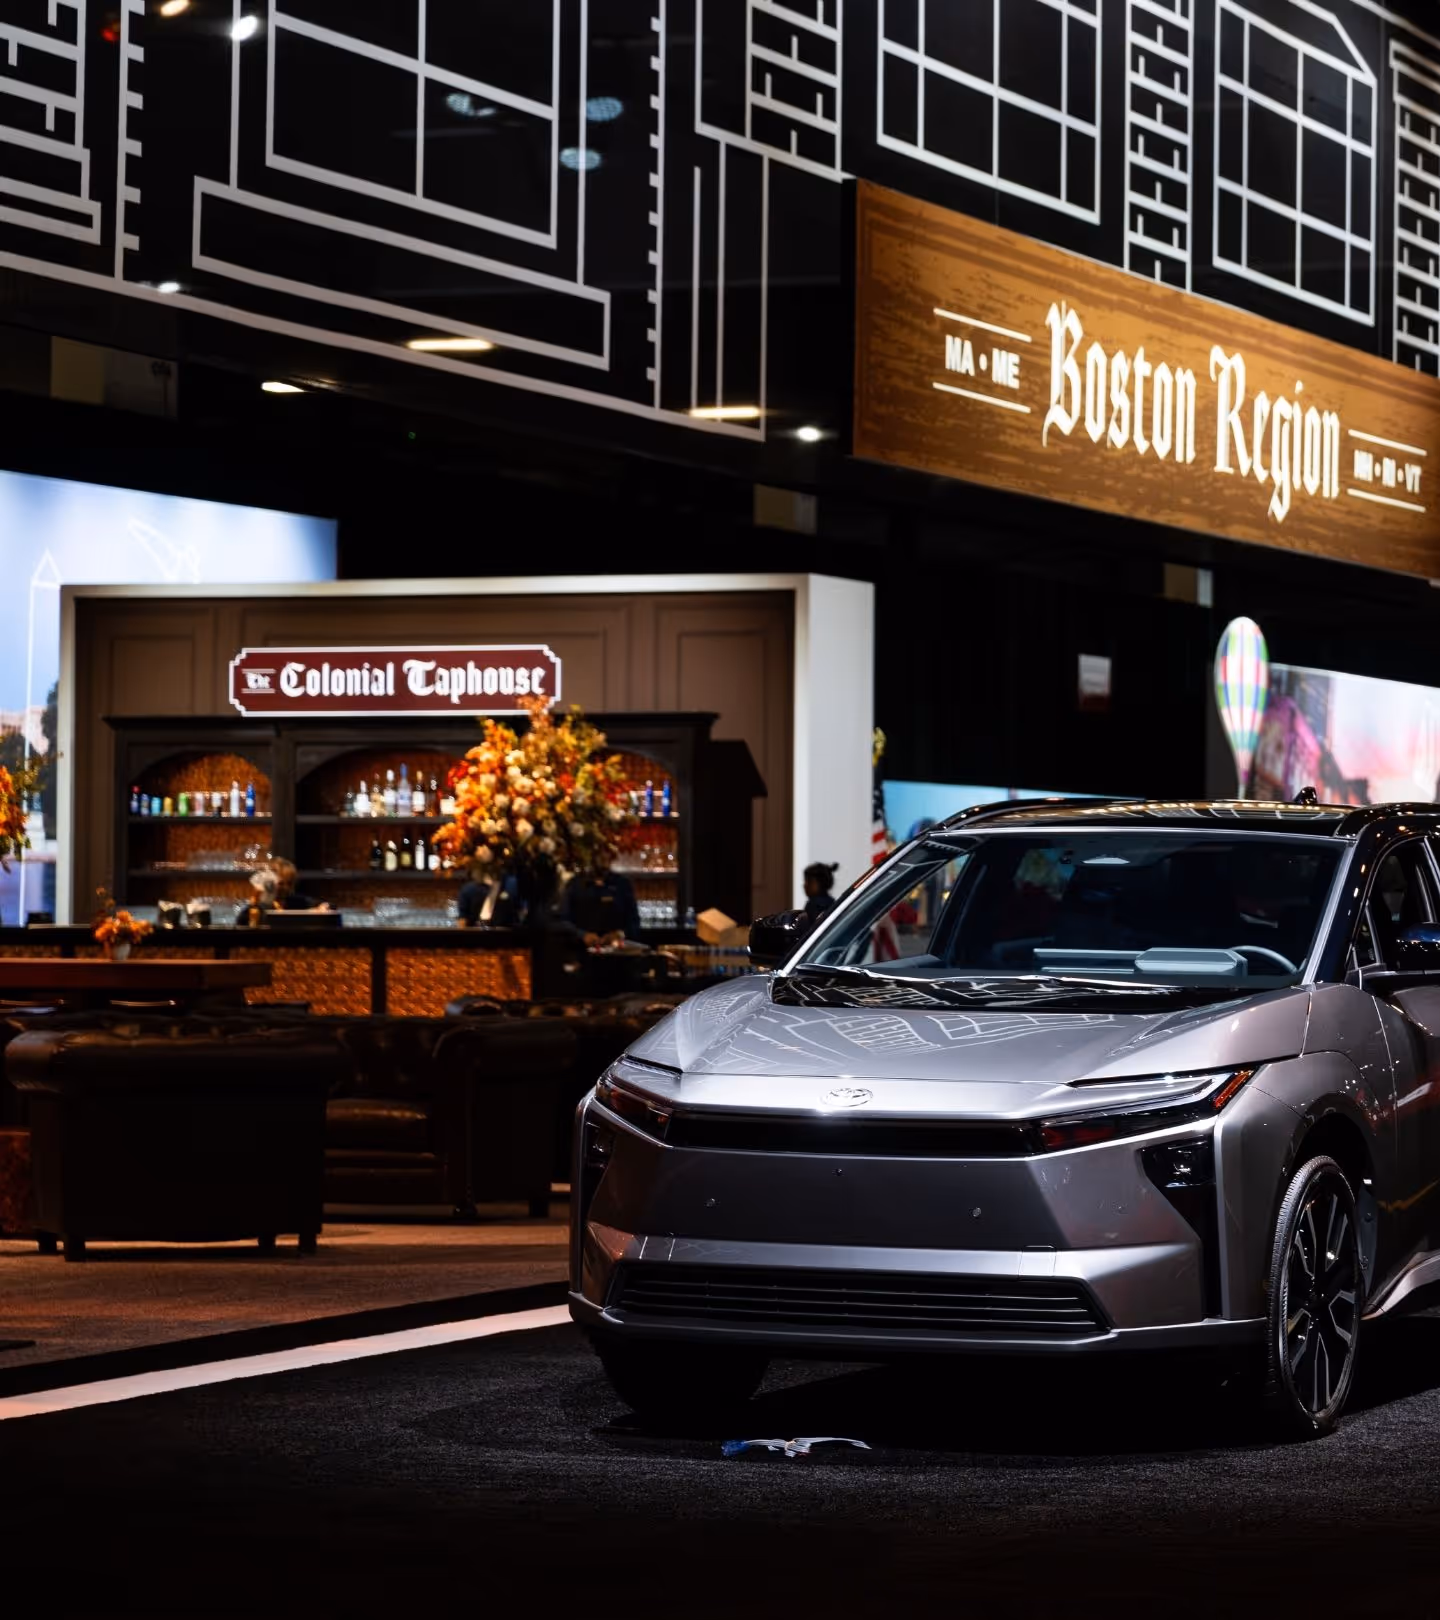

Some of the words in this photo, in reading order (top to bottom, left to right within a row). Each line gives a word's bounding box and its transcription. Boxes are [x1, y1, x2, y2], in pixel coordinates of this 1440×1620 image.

[945, 334, 975, 377] MA
[992, 347, 1020, 390] ME
[1042, 300, 1197, 464] Boston
[1210, 345, 1340, 523] Region
[1405, 462, 1422, 493] VT
[246, 672, 271, 689] The
[280, 661, 395, 697] Colonial
[402, 659, 546, 704] Taphouse
